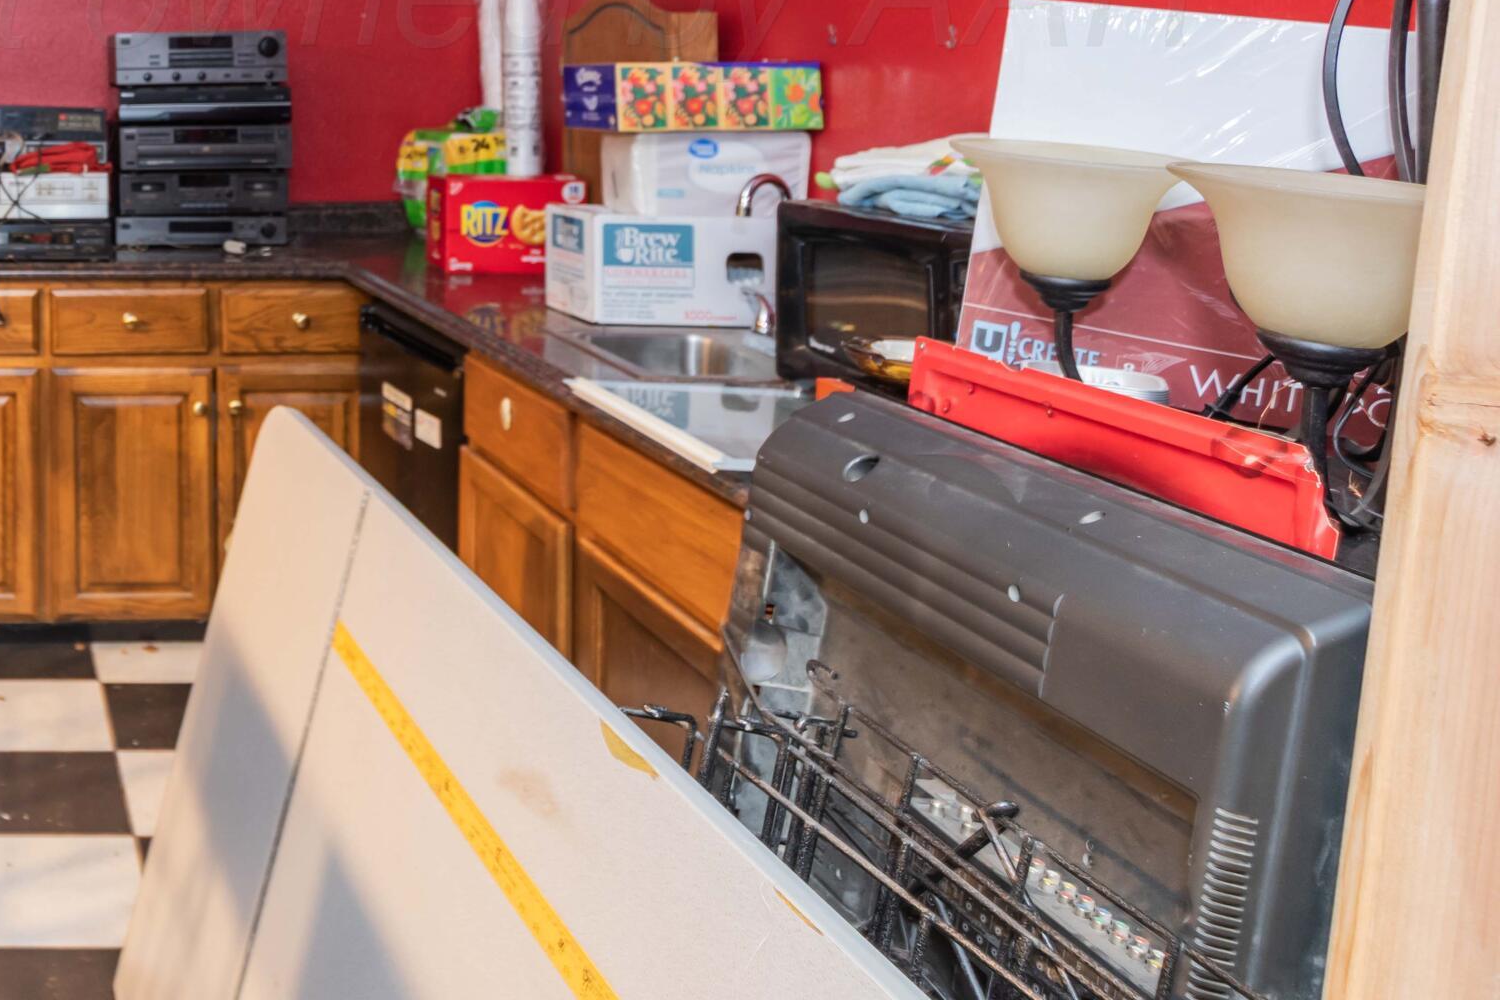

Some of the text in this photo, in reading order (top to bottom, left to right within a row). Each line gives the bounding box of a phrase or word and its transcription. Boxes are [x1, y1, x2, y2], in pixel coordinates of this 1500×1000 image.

[460, 203, 510, 237] RITZ
[622, 226, 681, 248] Brew
[633, 248, 679, 265] Rite
[1017, 337, 1100, 367] CRETE
[1189, 365, 1304, 413] WHIT
